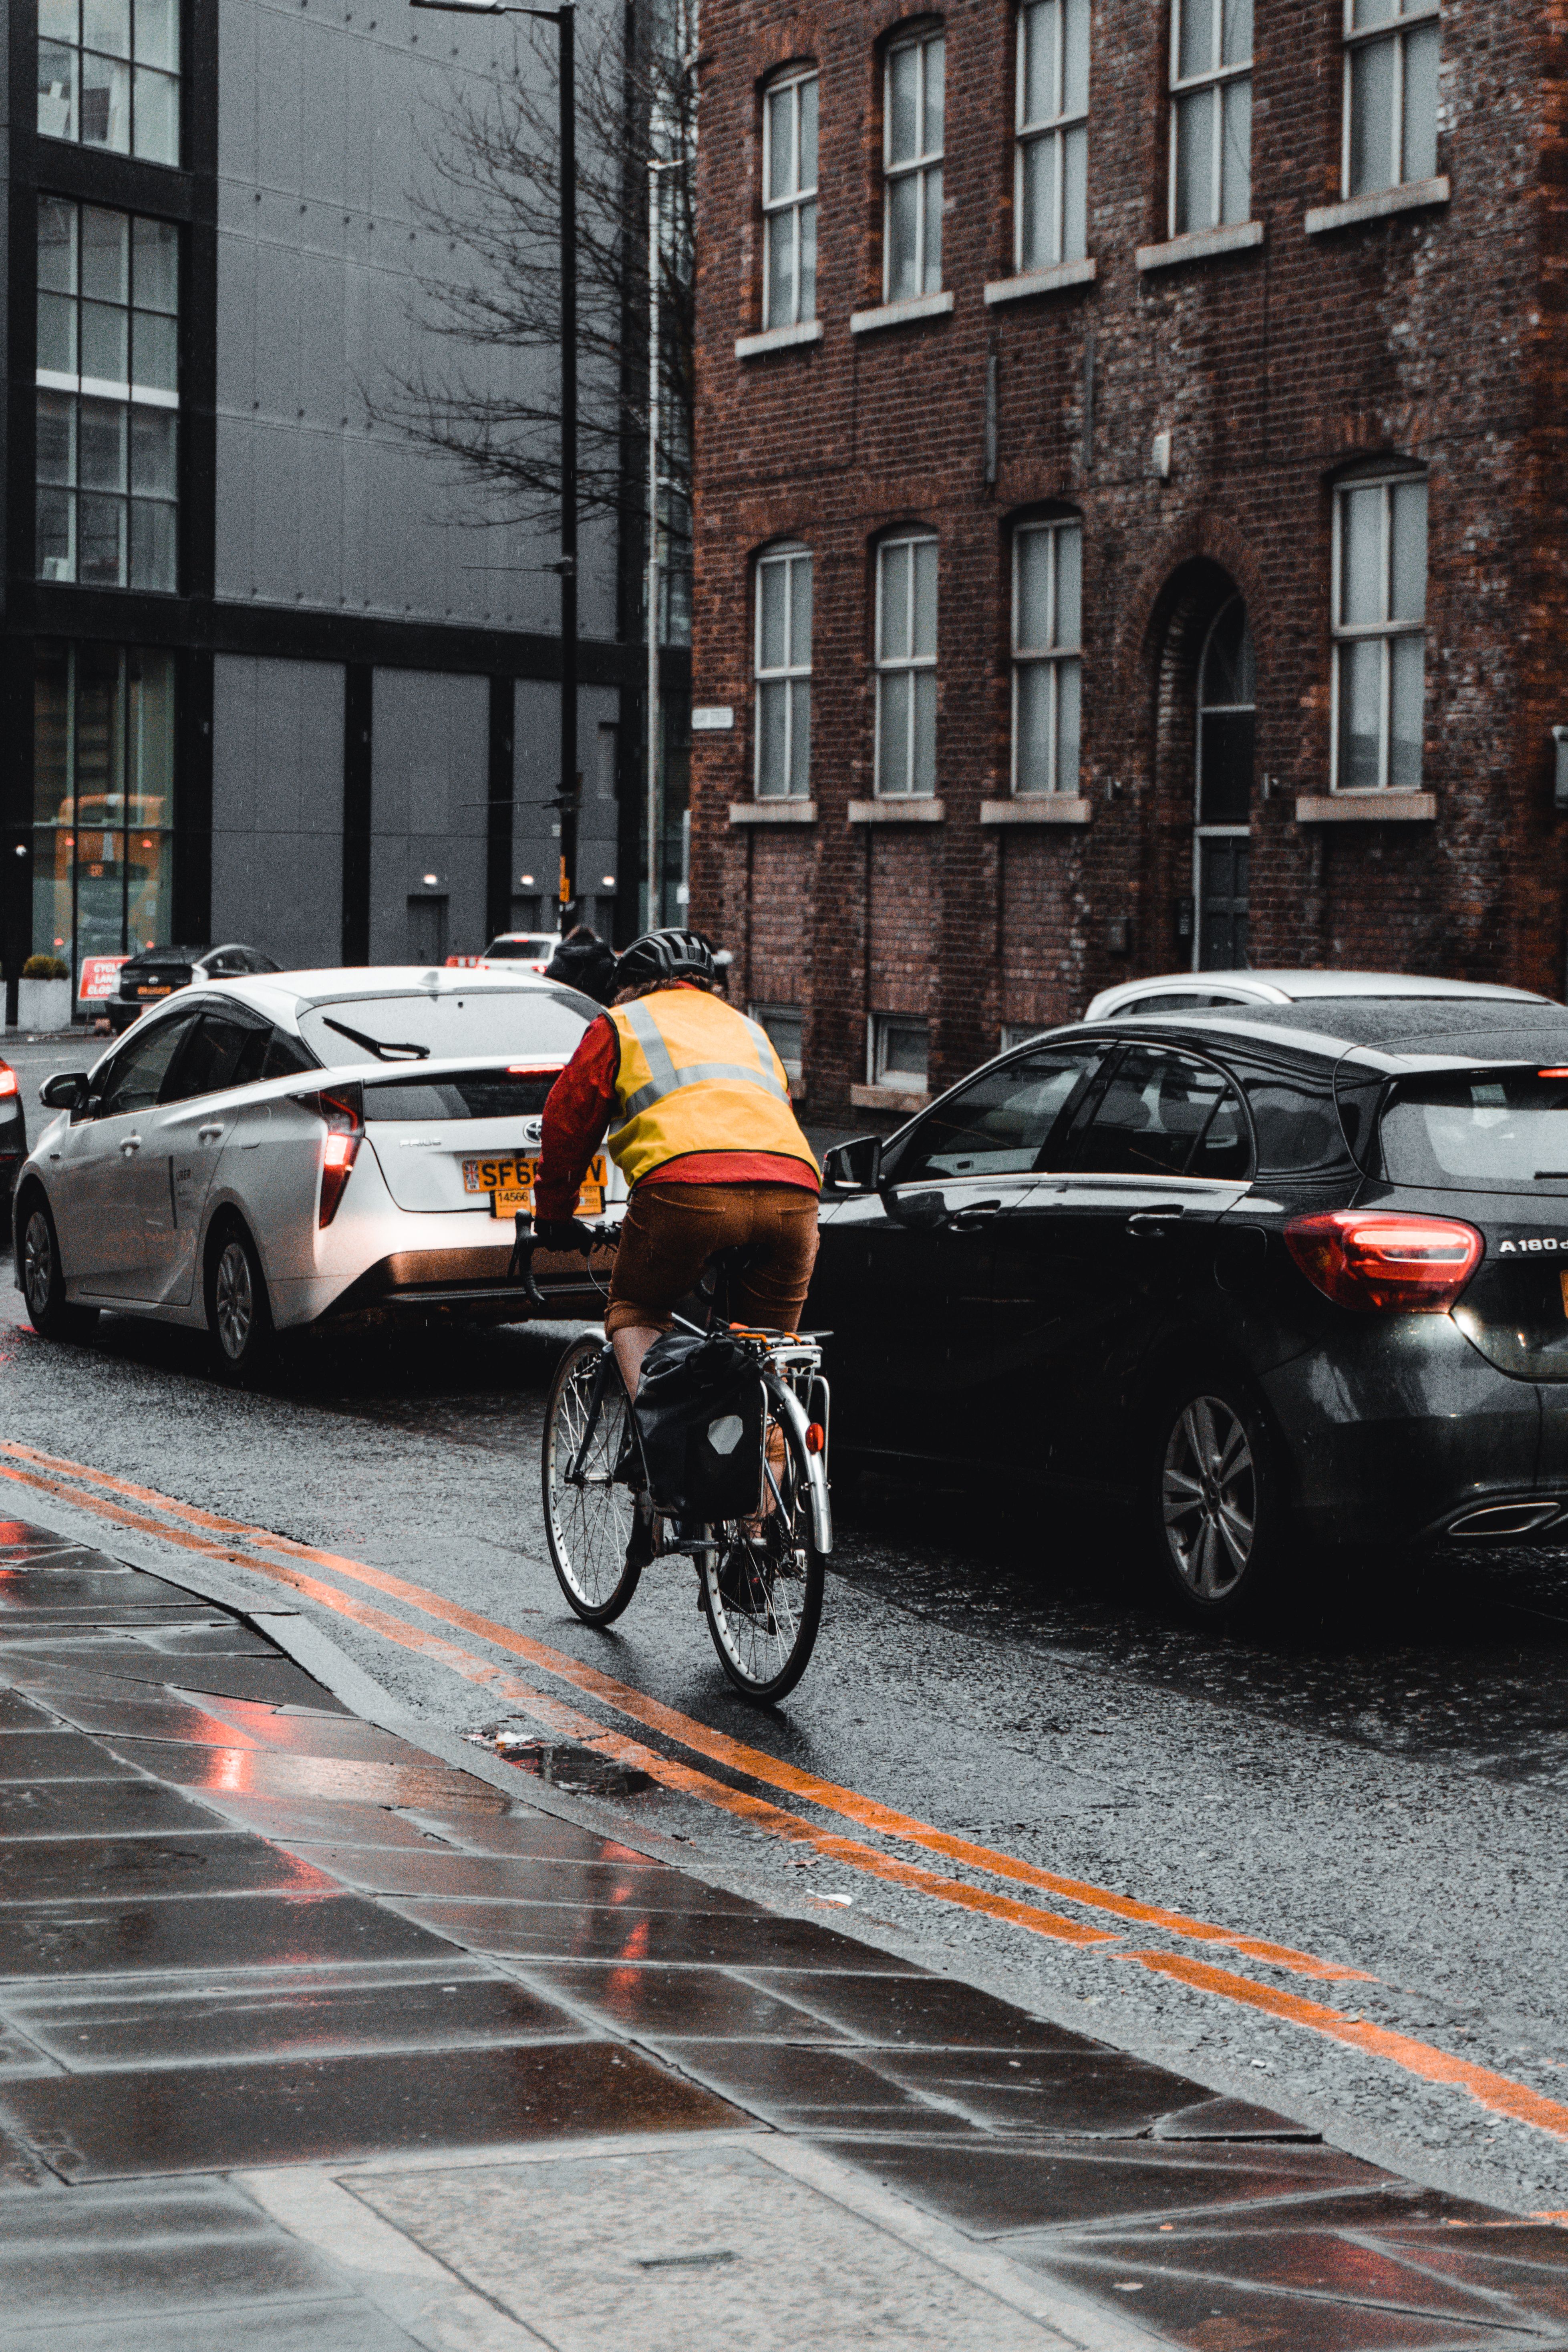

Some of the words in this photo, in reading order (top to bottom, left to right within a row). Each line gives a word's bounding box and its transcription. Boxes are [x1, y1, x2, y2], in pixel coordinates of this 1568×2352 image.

[95, 974, 113, 984] LAN
[88, 985, 111, 995] CLOS
[400, 1139, 441, 1147] PRIUS
[498, 1192, 528, 1202] 14566
